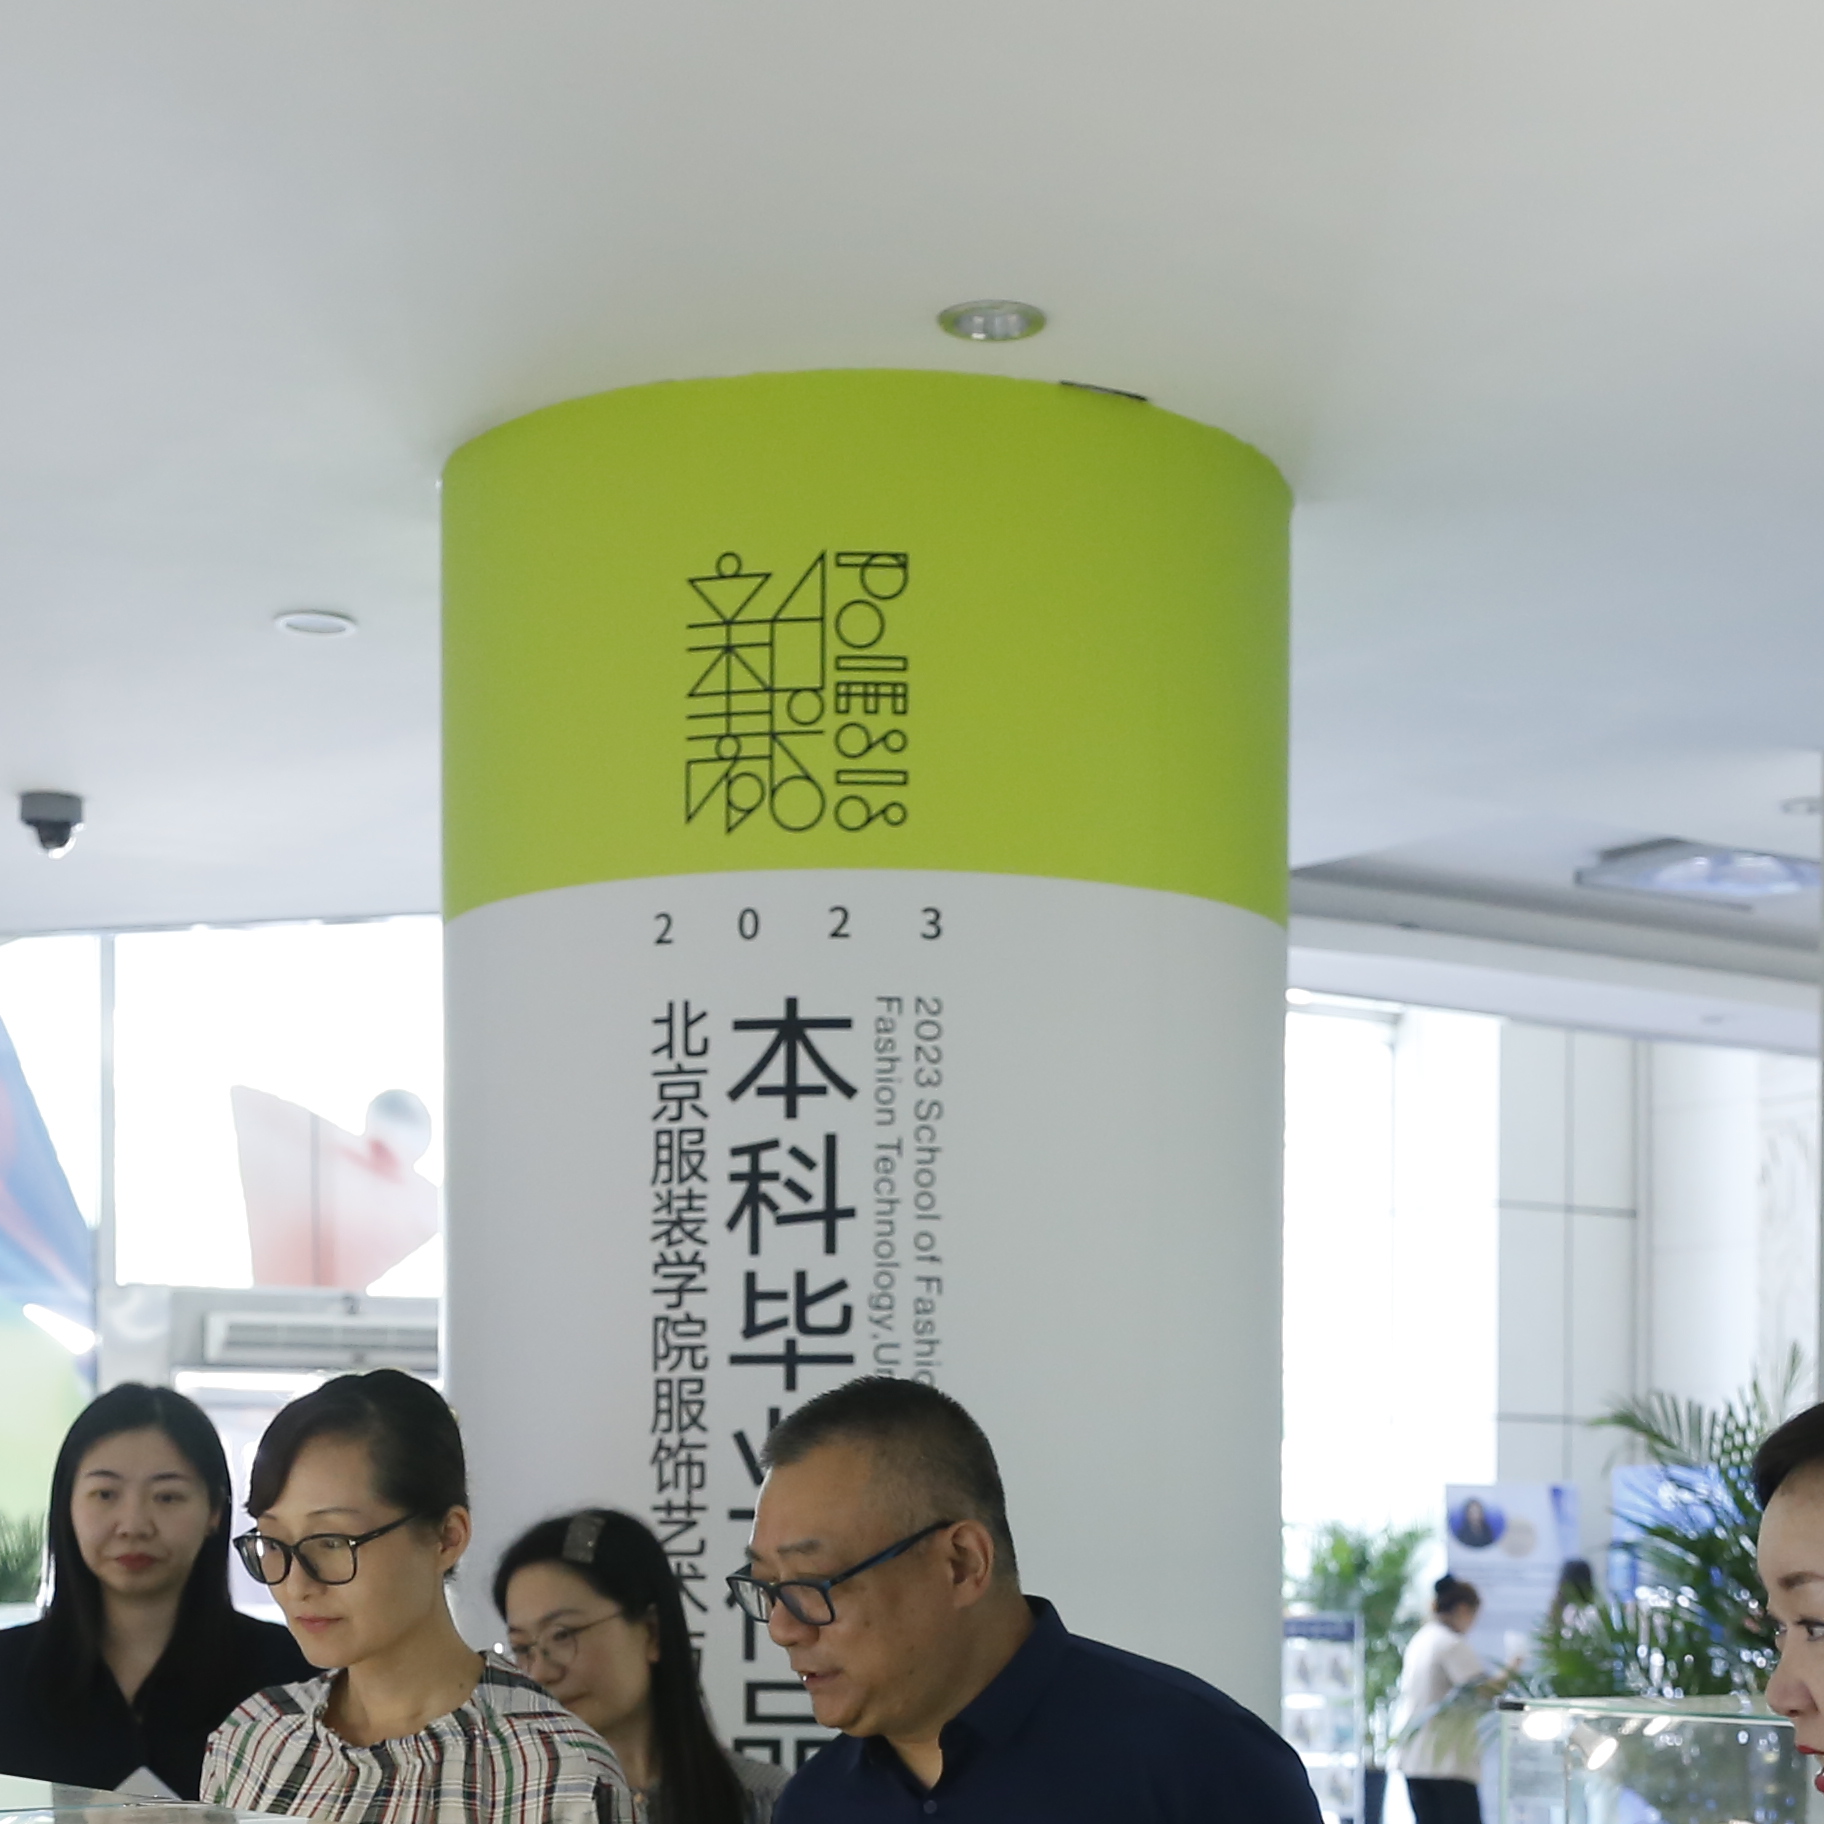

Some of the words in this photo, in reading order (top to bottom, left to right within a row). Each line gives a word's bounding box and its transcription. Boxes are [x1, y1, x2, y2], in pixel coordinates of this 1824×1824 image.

[874, 996, 903, 1126] Fashion
[913, 996, 943, 1089] 2023
[913, 1098, 944, 1220] School
[913, 1230, 942, 1264] of
